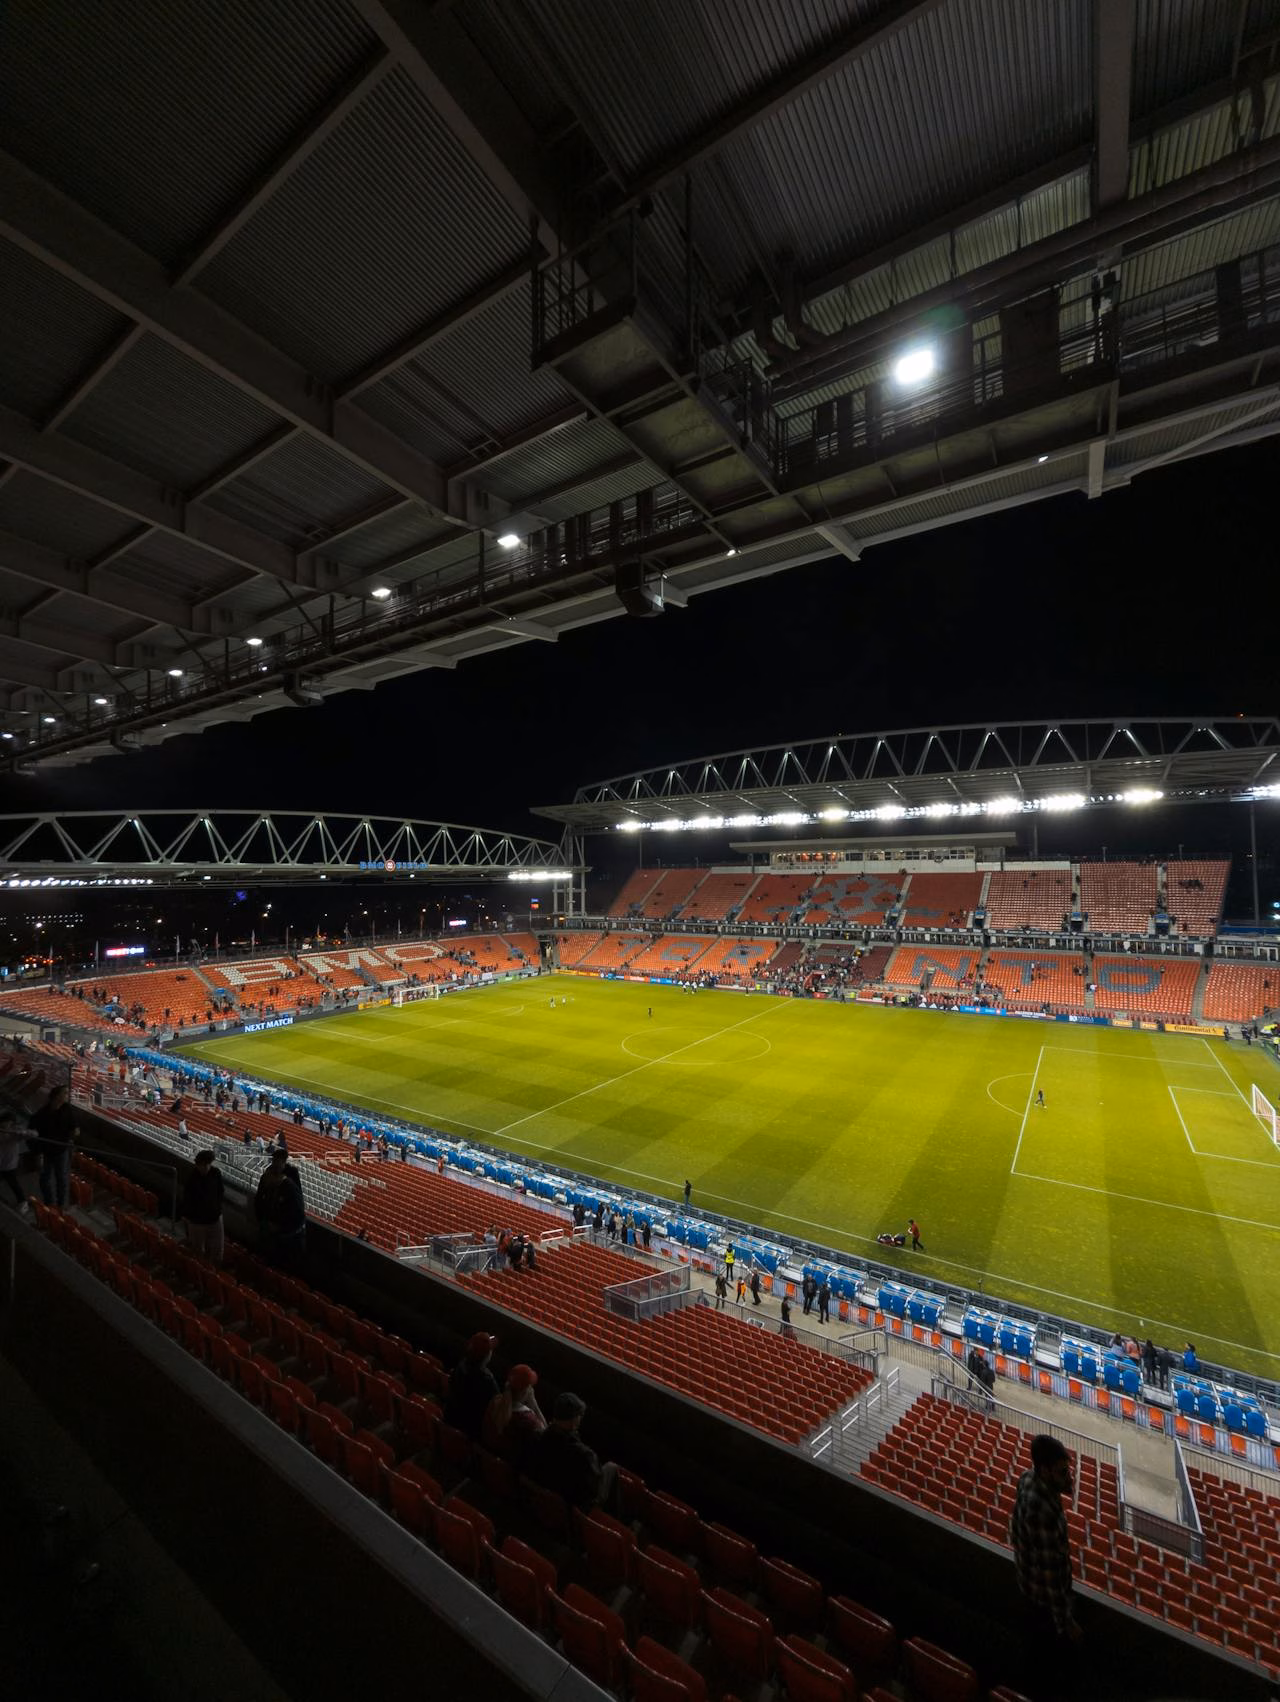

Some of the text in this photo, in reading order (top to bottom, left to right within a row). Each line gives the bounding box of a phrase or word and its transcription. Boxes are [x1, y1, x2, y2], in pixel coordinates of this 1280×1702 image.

[214, 944, 445, 986] BMO
[244, 1017, 294, 1033] NEXT MATCH
